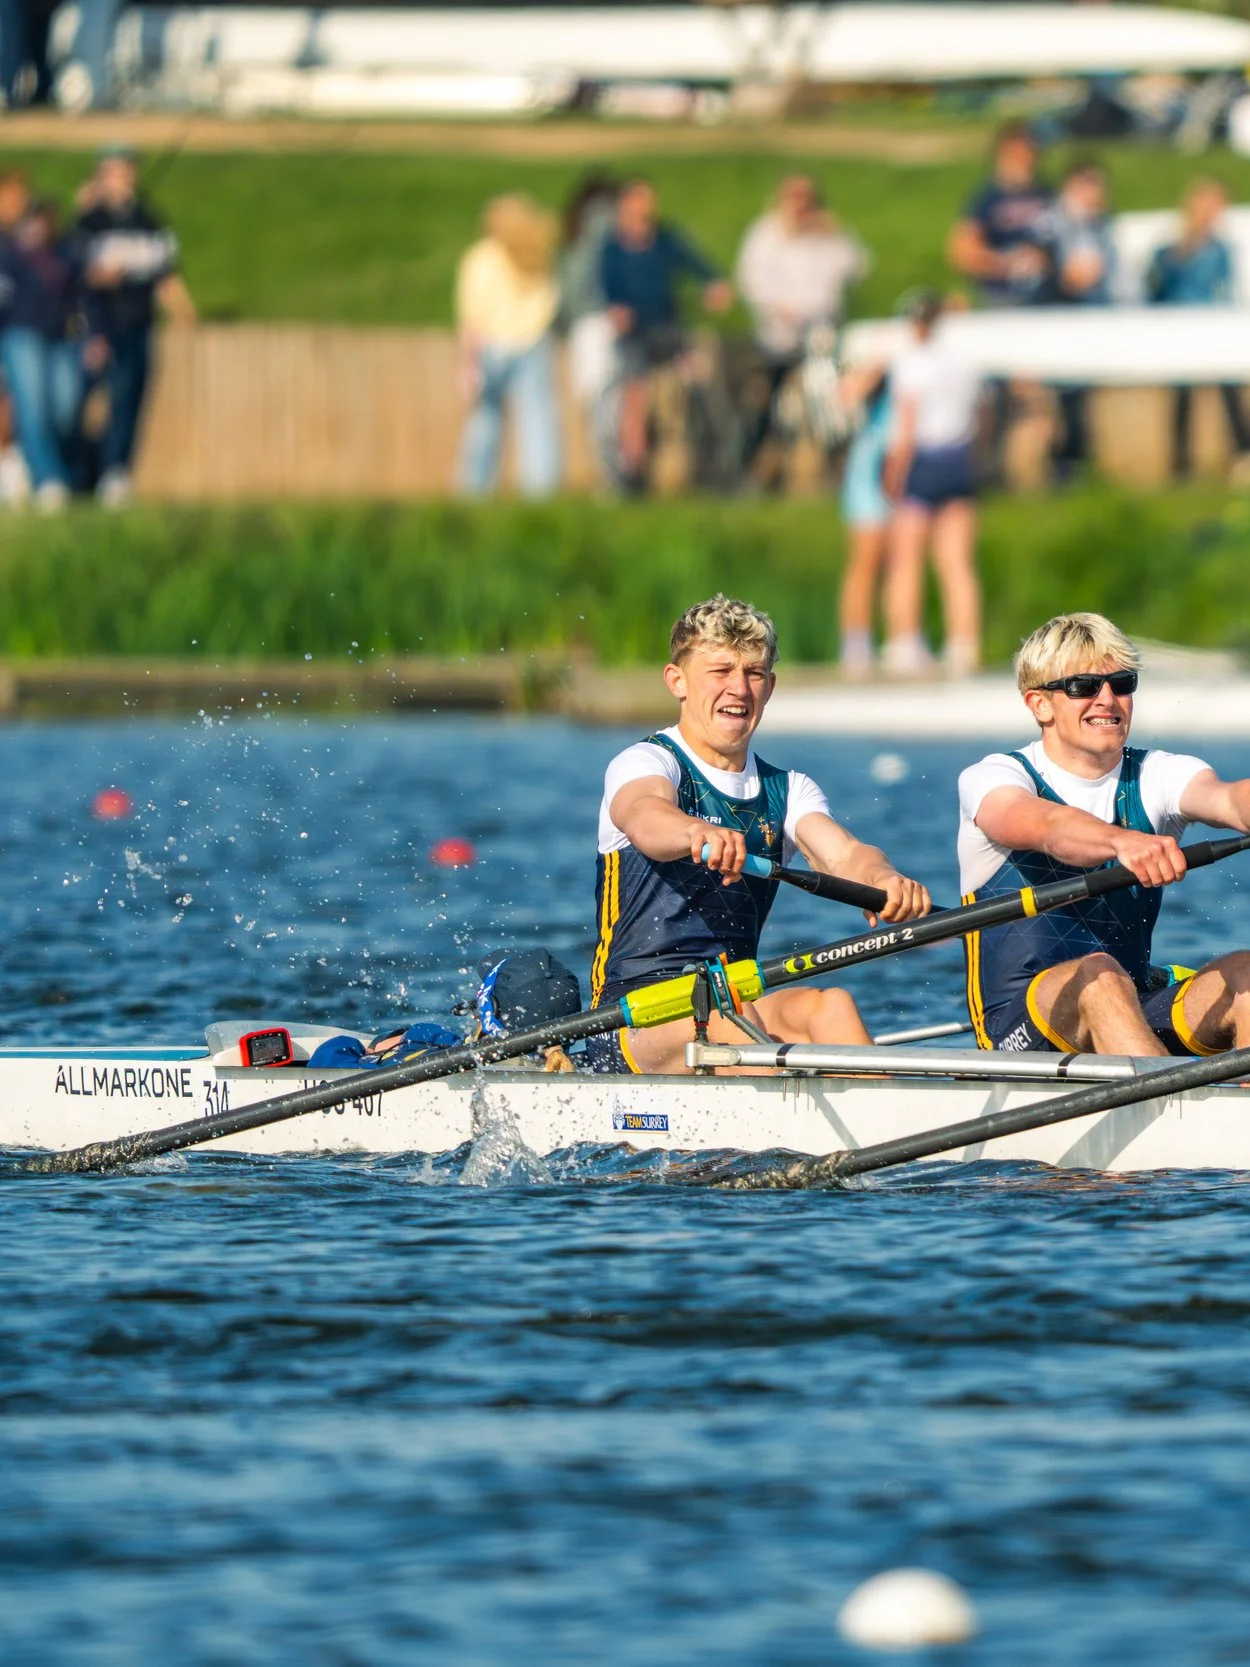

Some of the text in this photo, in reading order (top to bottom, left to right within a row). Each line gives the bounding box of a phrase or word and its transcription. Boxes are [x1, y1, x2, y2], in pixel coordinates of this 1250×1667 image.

[816, 928, 914, 964] concept 2
[55, 1065, 194, 1098] ALLMARKONE
